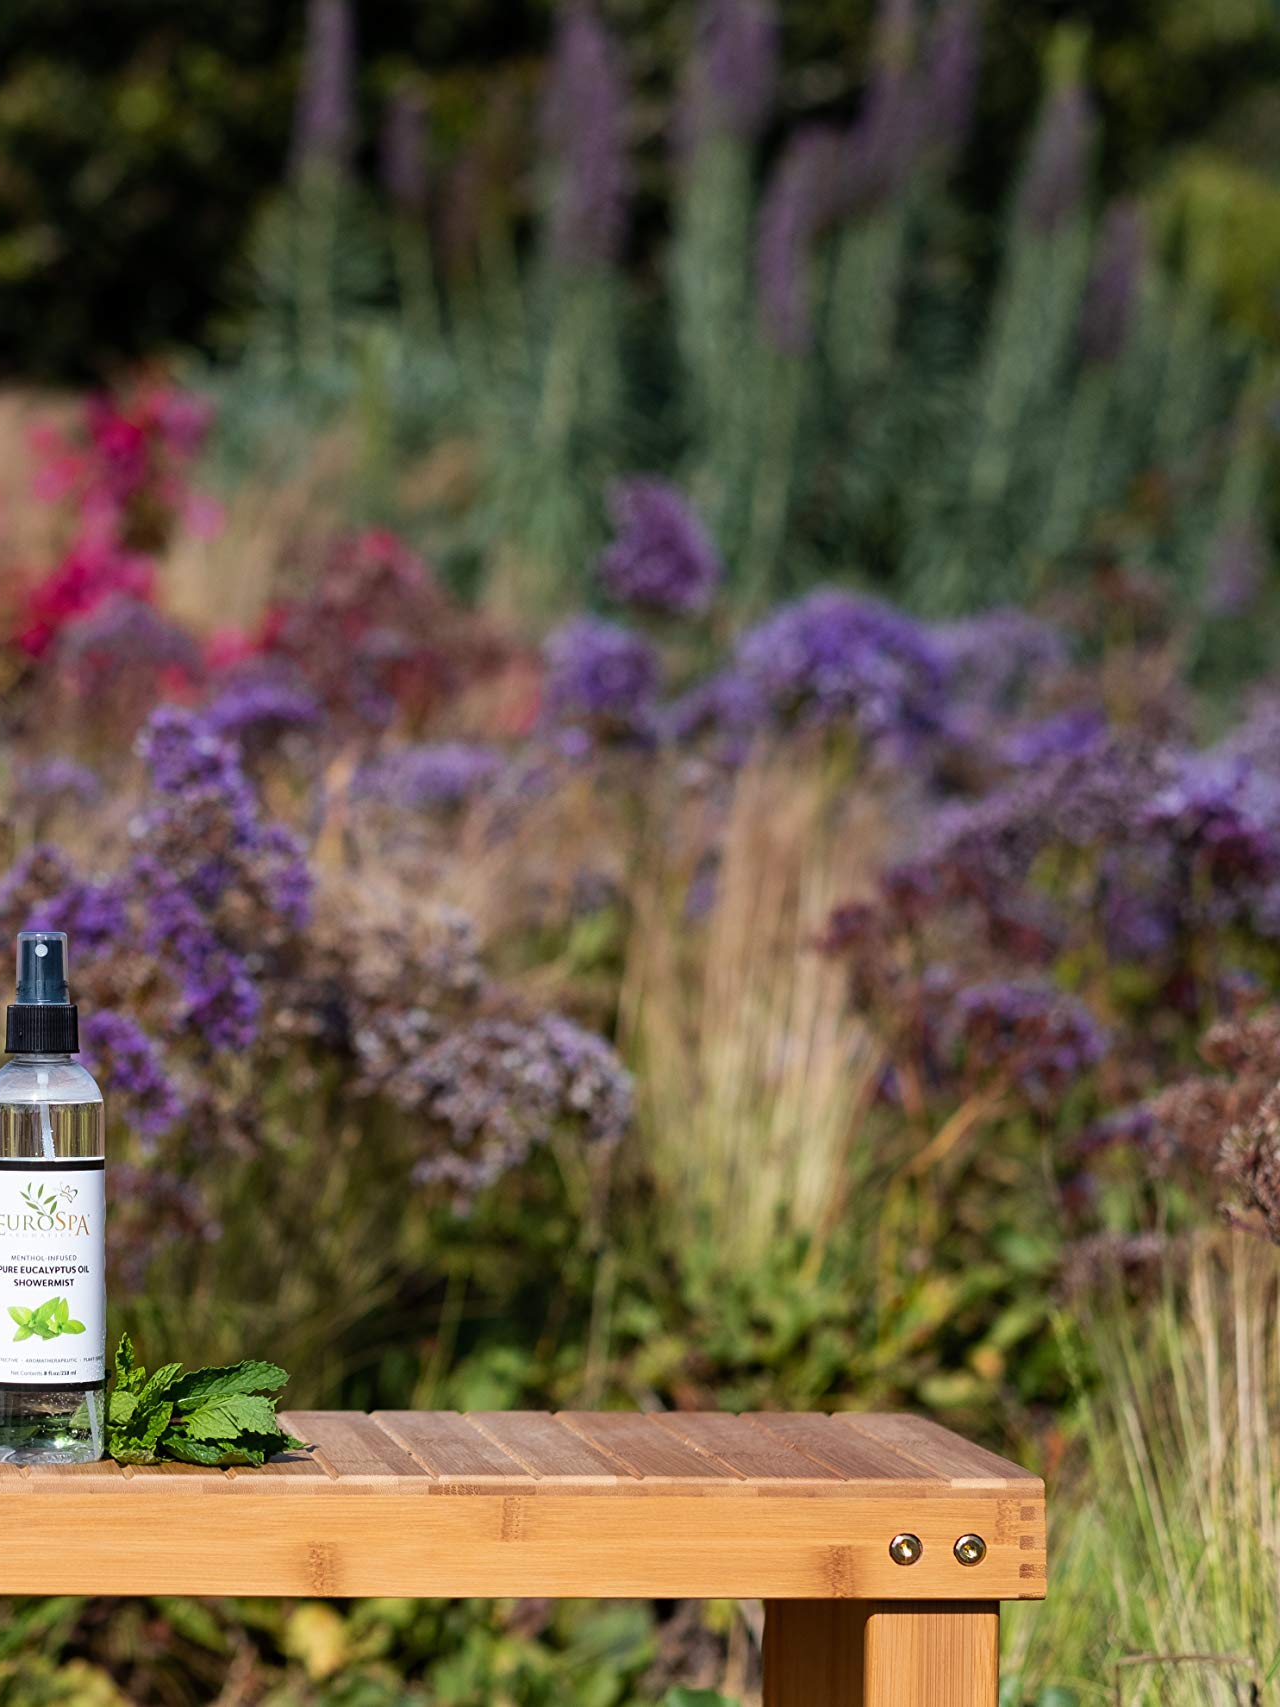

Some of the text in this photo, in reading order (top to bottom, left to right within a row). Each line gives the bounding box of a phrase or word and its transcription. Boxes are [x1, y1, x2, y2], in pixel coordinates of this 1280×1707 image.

[20, 1266, 76, 1274] EUCALYPTUS
[77, 1265, 89, 1273] OIL
[13, 1279, 74, 1287] SHOWERMIST
